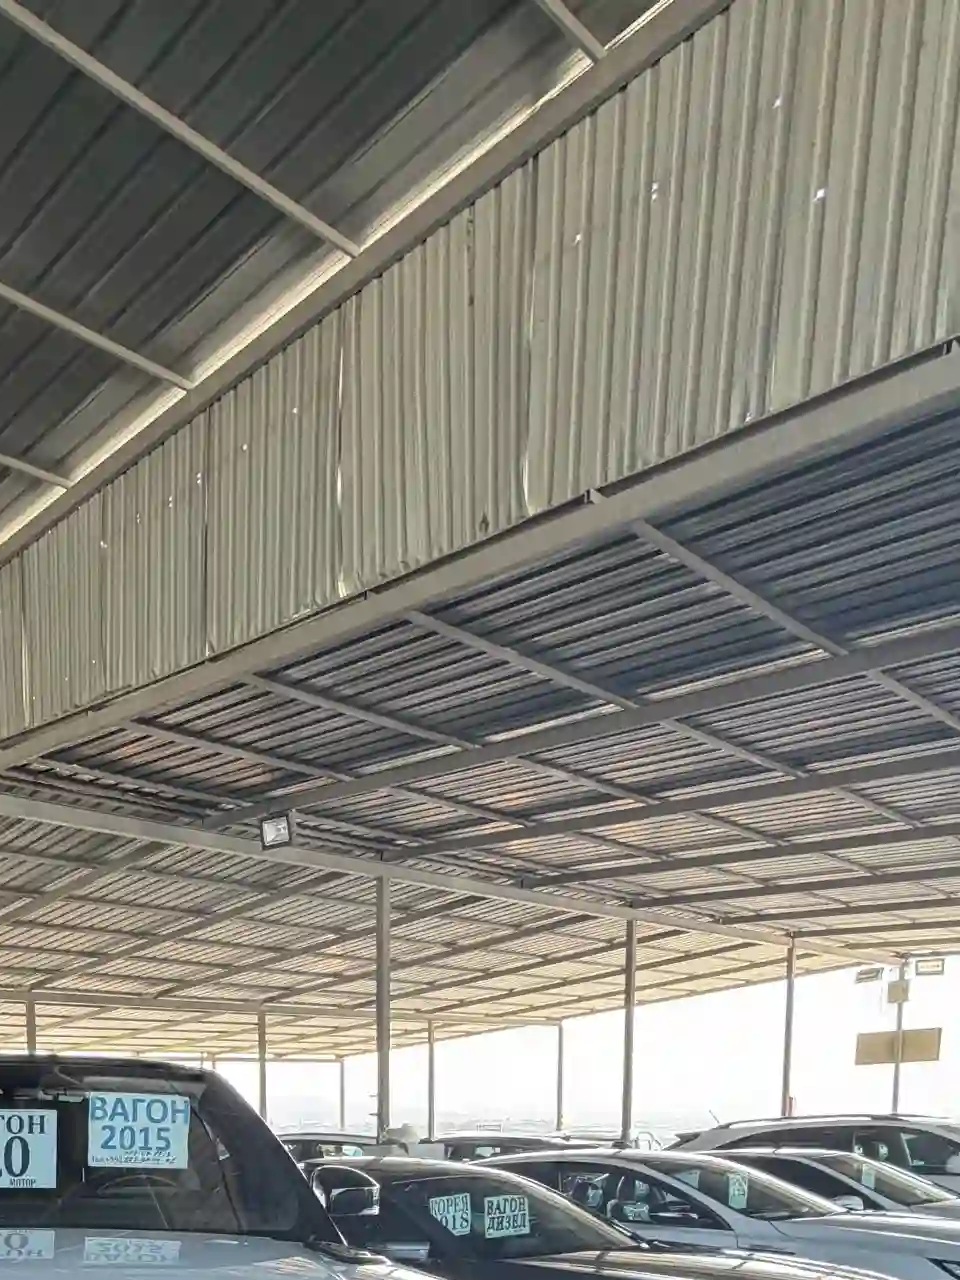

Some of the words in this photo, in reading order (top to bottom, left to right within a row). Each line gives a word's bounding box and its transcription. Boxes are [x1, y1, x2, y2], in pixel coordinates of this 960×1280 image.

[89, 1096, 189, 1125] ВАГОН
[100, 1126, 172, 1151] 2015
[487, 1197, 526, 1216] ВАГОН
[440, 1212, 469, 1231] 018
